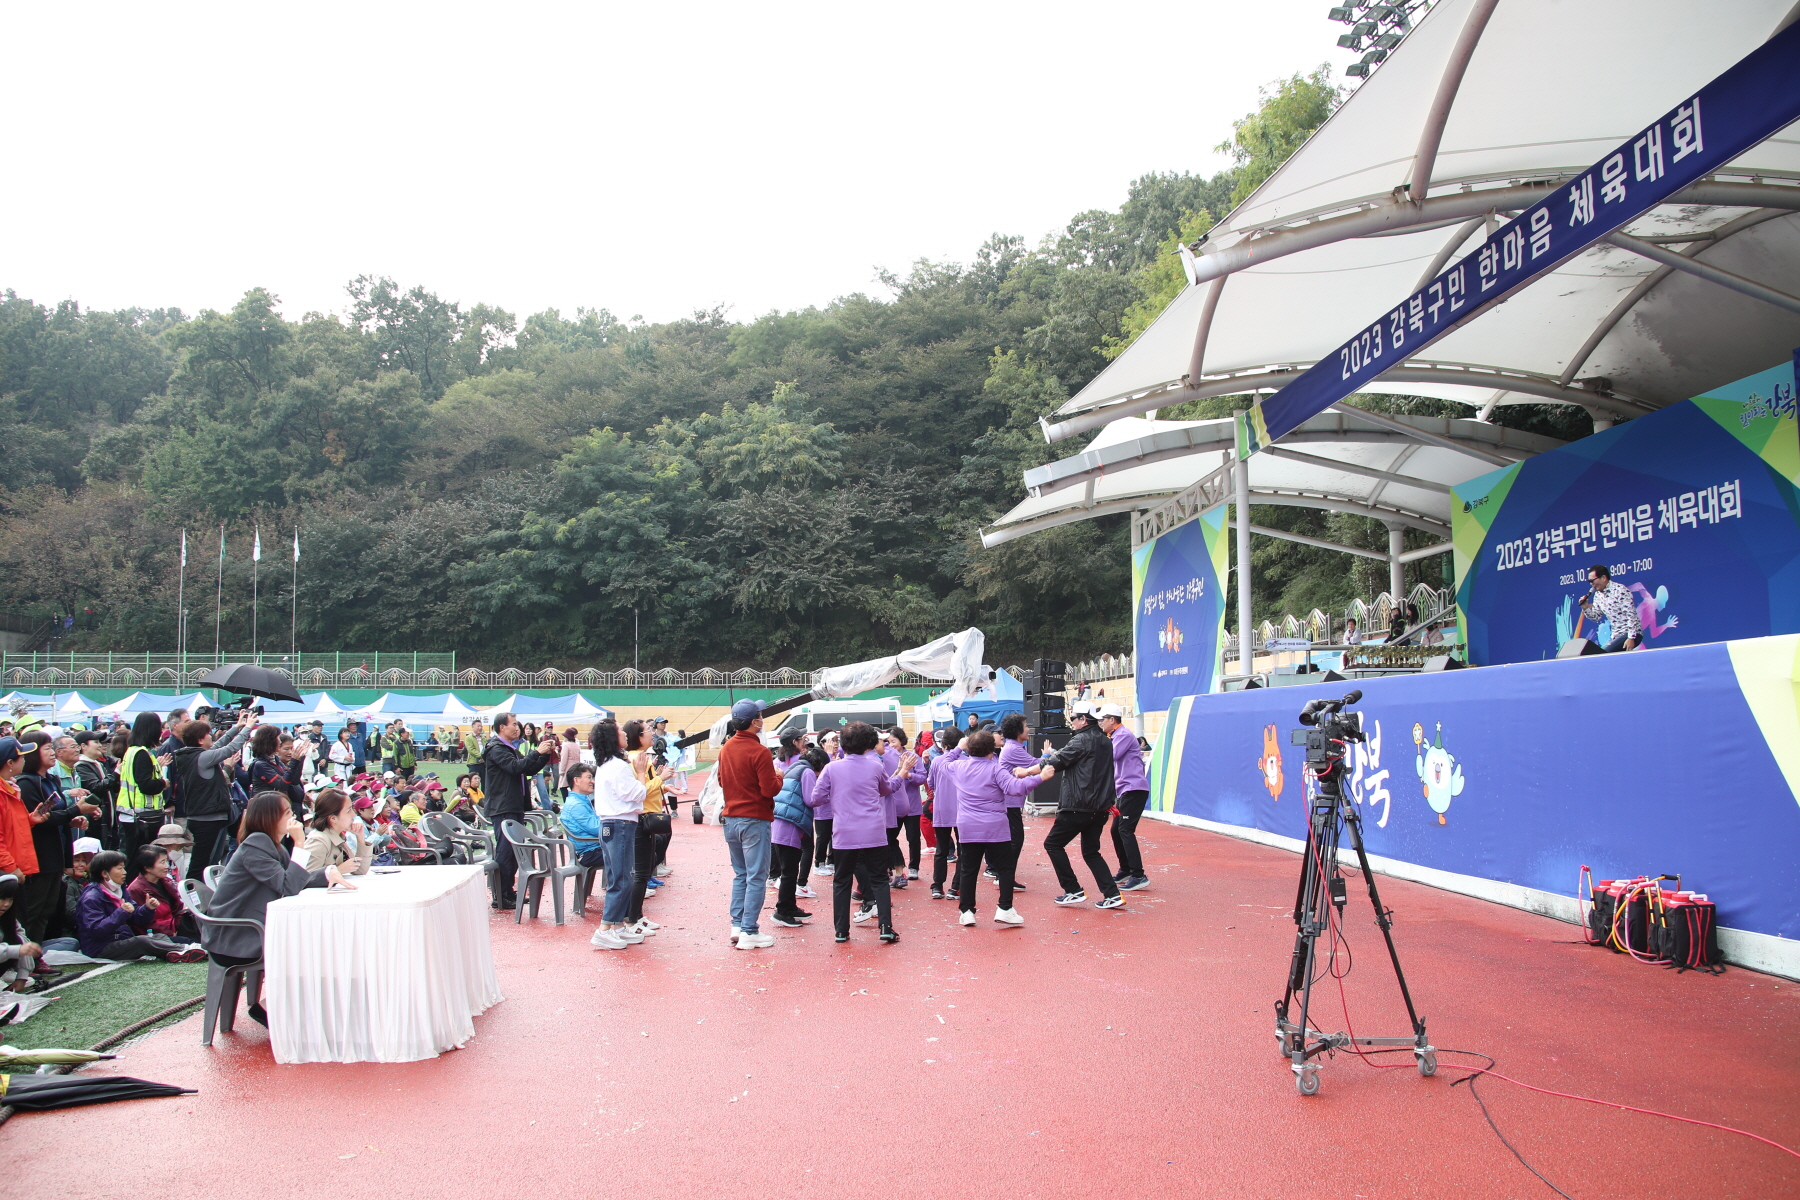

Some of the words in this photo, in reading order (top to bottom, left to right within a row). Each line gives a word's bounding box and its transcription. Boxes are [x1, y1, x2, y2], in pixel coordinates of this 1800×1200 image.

[1341, 323, 1383, 381] 2023
[1390, 264, 1466, 349] 강북구민
[1478, 206, 1553, 293] 한마음
[1568, 96, 1704, 228] 체육대회
[1765, 382, 1796, 420] 강북
[1472, 495, 1490, 509] 강북구
[1496, 537, 1533, 571] 2023
[1535, 517, 1597, 564] 강북구민
[1600, 503, 1654, 549] 한마음
[1657, 479, 1742, 534] 체육대회
[1560, 573, 1576, 586] 2023.
[1575, 568, 1587, 583] 10.
[1632, 557, 1653, 573] 17:00
